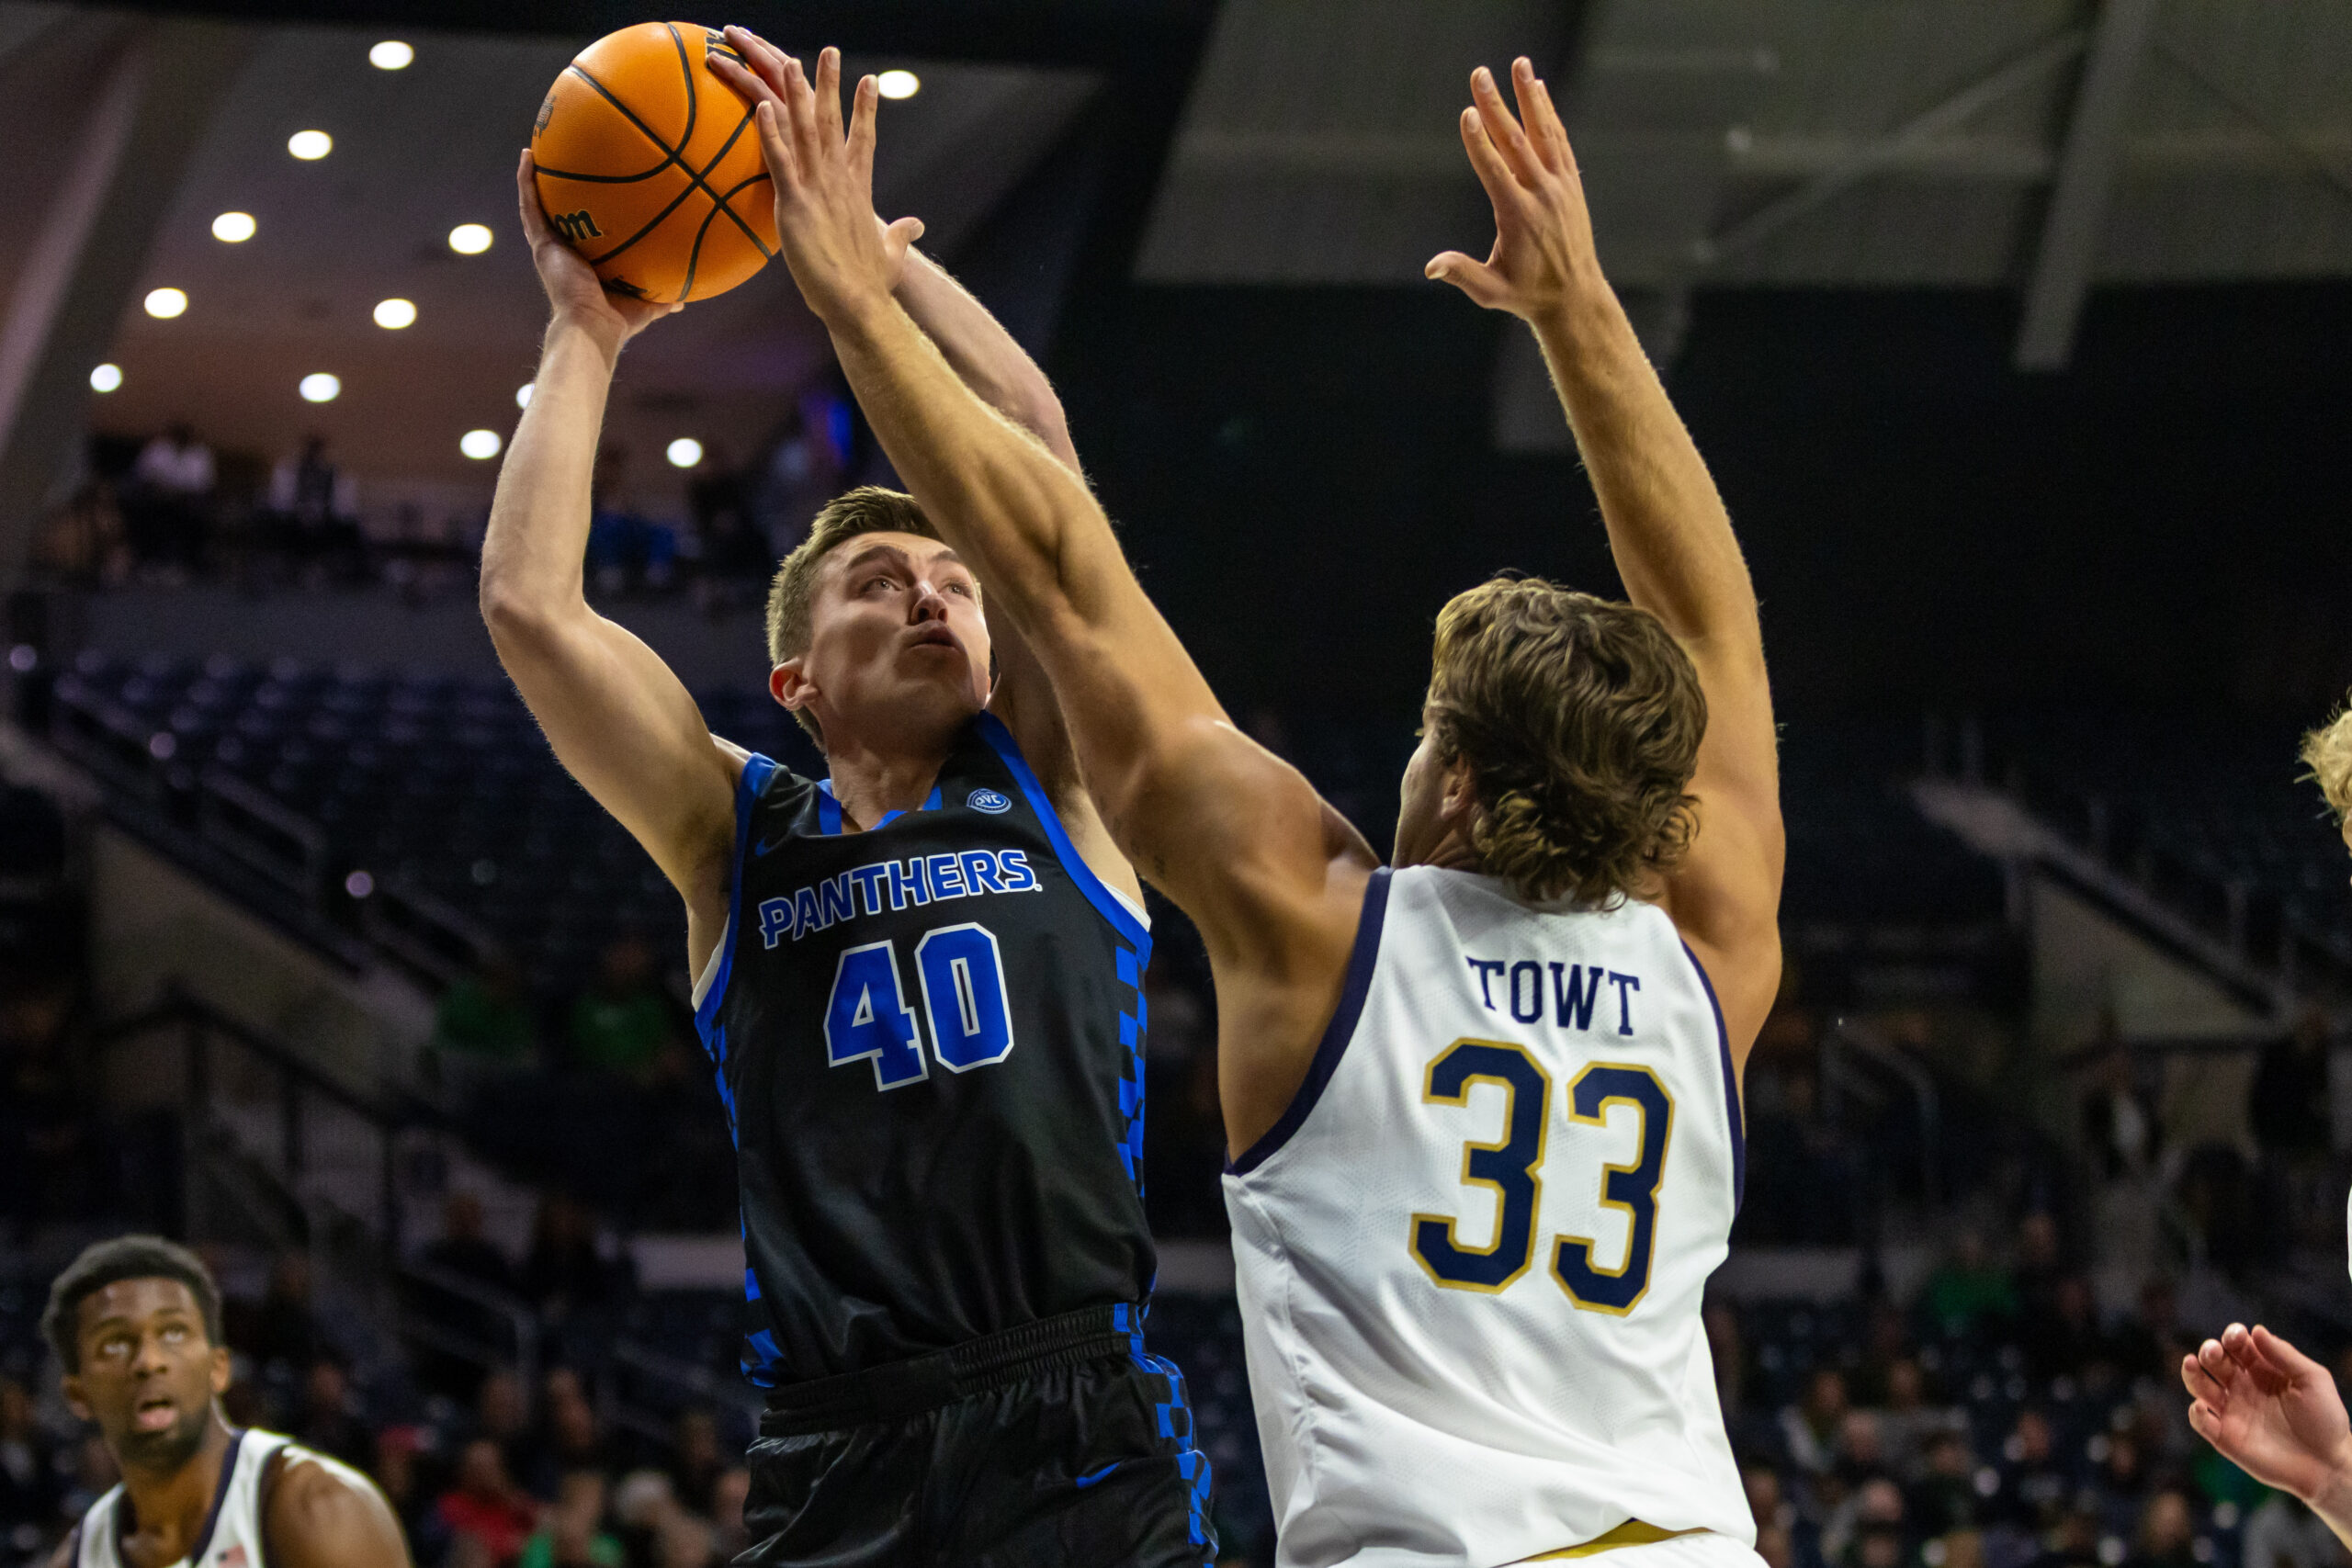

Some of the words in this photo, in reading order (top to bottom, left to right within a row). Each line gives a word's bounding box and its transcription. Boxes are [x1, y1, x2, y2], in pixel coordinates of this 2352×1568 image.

[759, 850, 1039, 949] PANTHERS
[823, 921, 1014, 1092] 40
[1465, 955, 1641, 1036] TOWT
[1408, 1037, 1676, 1317] 33
